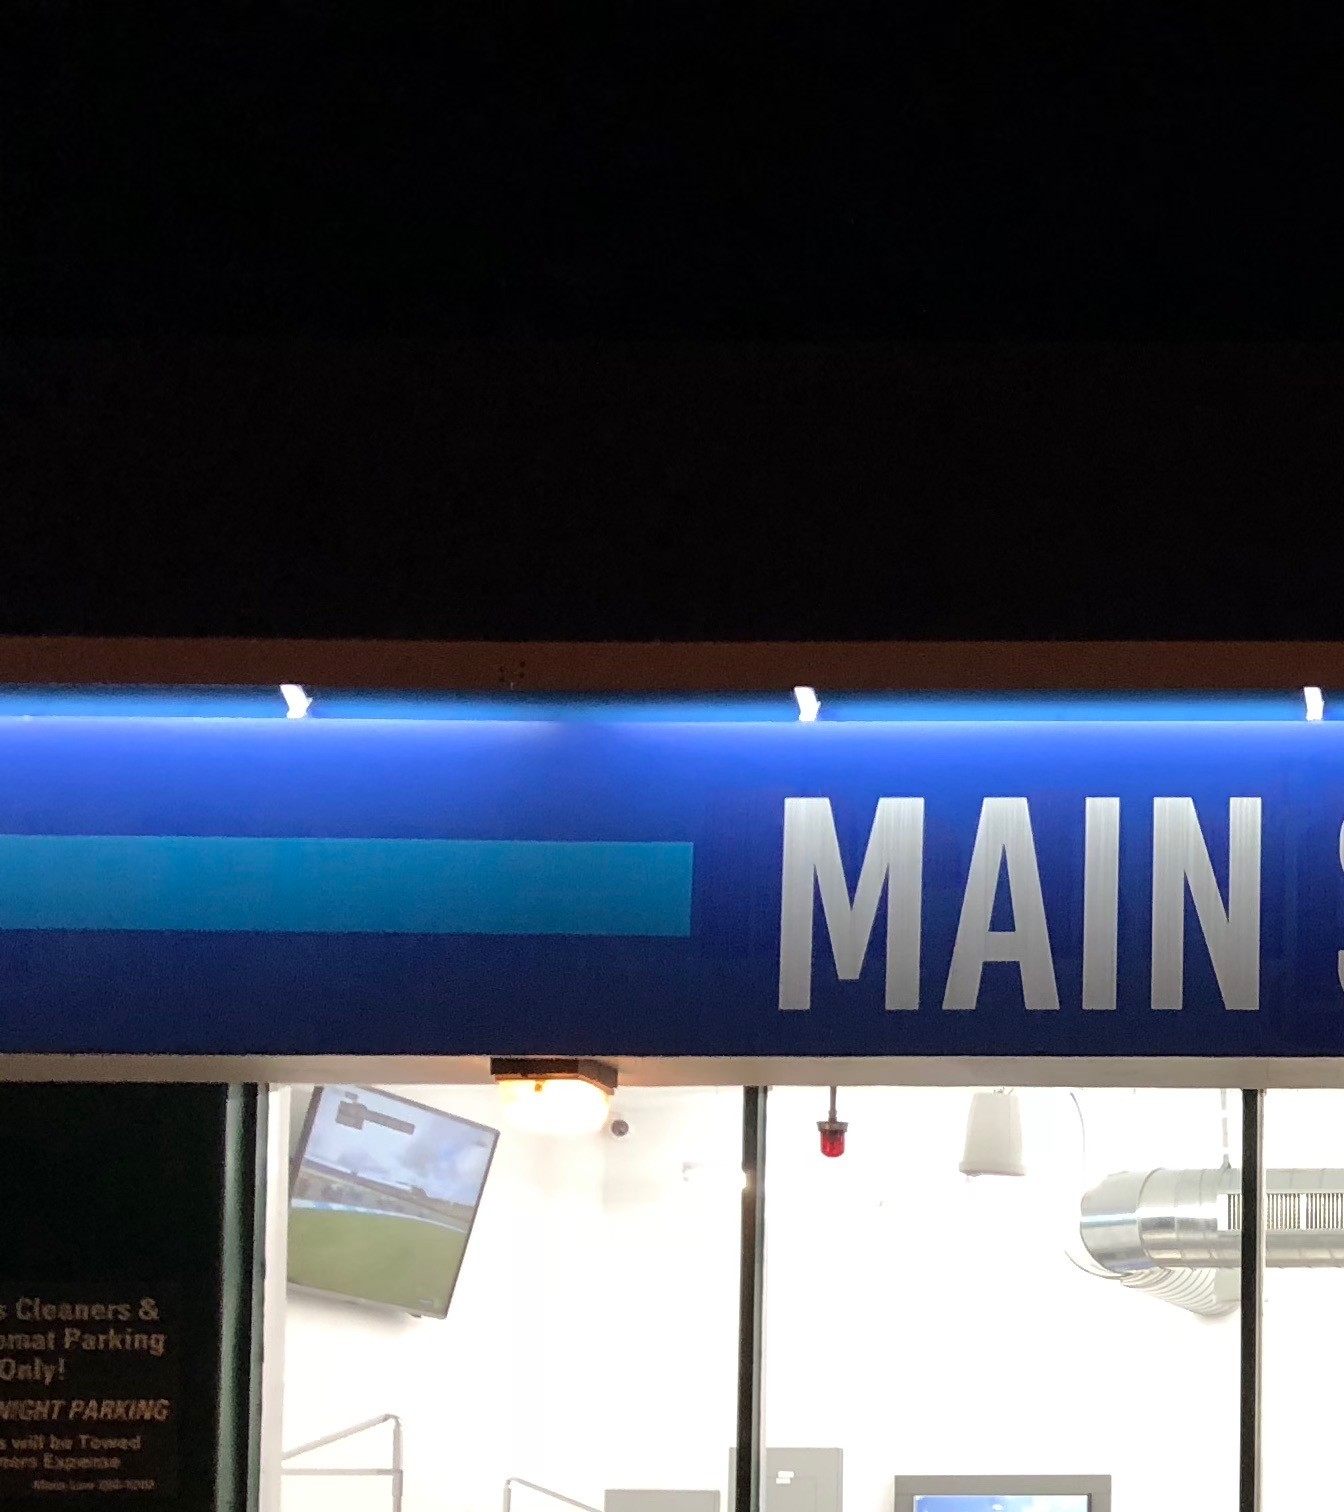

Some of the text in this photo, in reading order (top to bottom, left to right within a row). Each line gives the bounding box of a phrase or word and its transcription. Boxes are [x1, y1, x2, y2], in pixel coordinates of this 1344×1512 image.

[778, 797, 1263, 1011] MAIN
[16, 1297, 132, 1321] Cleaners
[138, 1297, 161, 1321] &
[64, 1327, 168, 1357] Parking
[0, 1357, 65, 1386] Only!
[68, 1398, 171, 1421] PARKING
[11, 1433, 45, 1450] will
[79, 1433, 142, 1450] Towed
[43, 1452, 122, 1470] Expense
